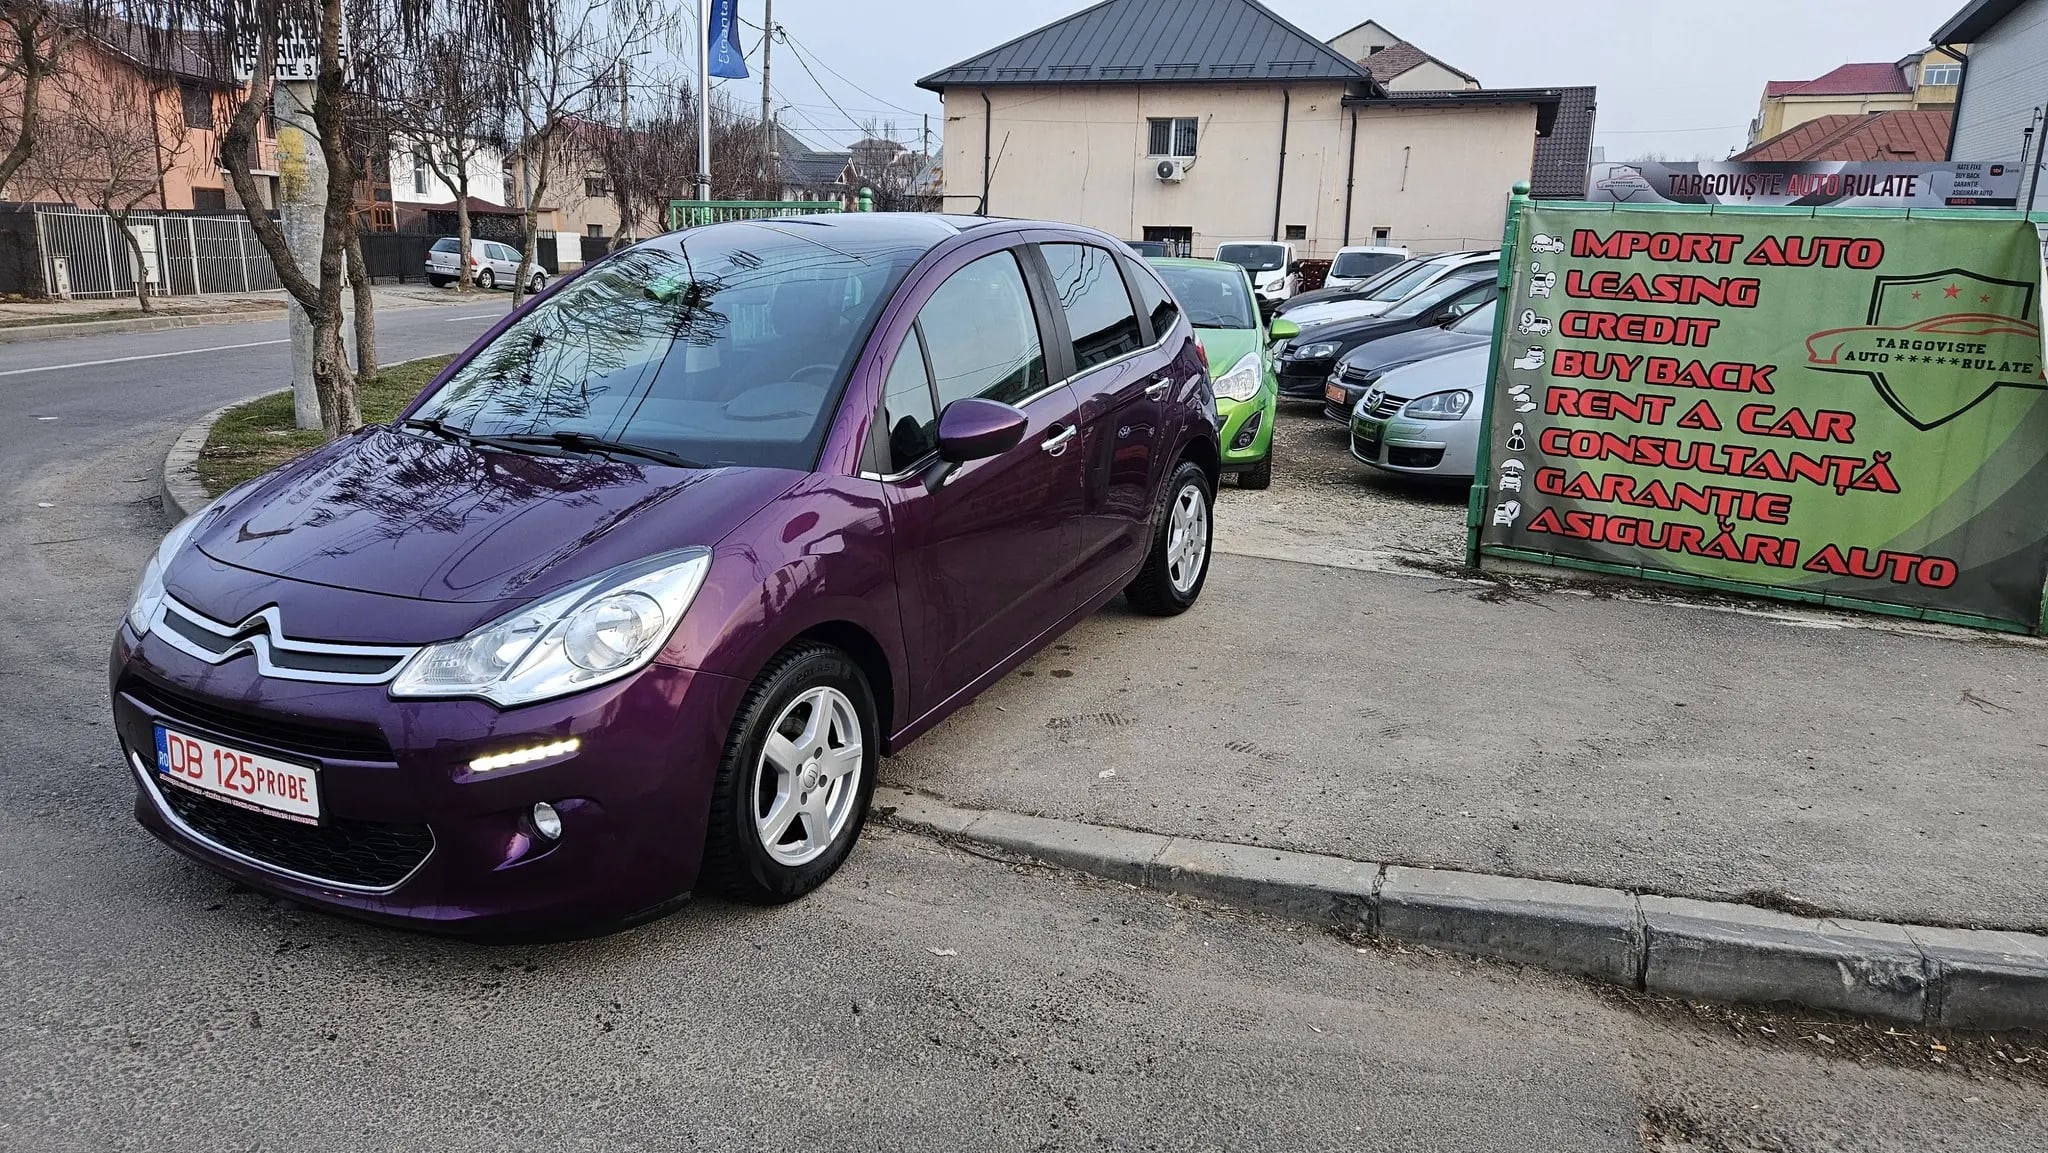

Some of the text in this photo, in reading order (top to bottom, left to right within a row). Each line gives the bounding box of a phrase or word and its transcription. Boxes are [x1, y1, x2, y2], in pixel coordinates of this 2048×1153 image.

[244, 63, 298, 76] PTE
[1785, 174, 1840, 196] AUTO
[1843, 174, 1919, 197] RULATE
[1571, 229, 1884, 269] IMPORT AUTO
[1565, 270, 1760, 307] LEASING
[1559, 310, 1720, 347] CREDIT
[1876, 337, 1987, 355] TARGOVISTE
[1552, 350, 1777, 394] BUY BACK
[1845, 351, 1889, 364] AUTO
[1545, 386, 1856, 443] RENT A CAR
[1539, 427, 1901, 495] CONSULTANȚĂ
[1534, 466, 1792, 523] GARANȚIE
[1527, 506, 1959, 589] ASIGURĂRI AUTO
[158, 751, 169, 768] RO
[169, 734, 204, 779] DB
[213, 749, 256, 794] 125
[257, 767, 309, 803] PROBE
